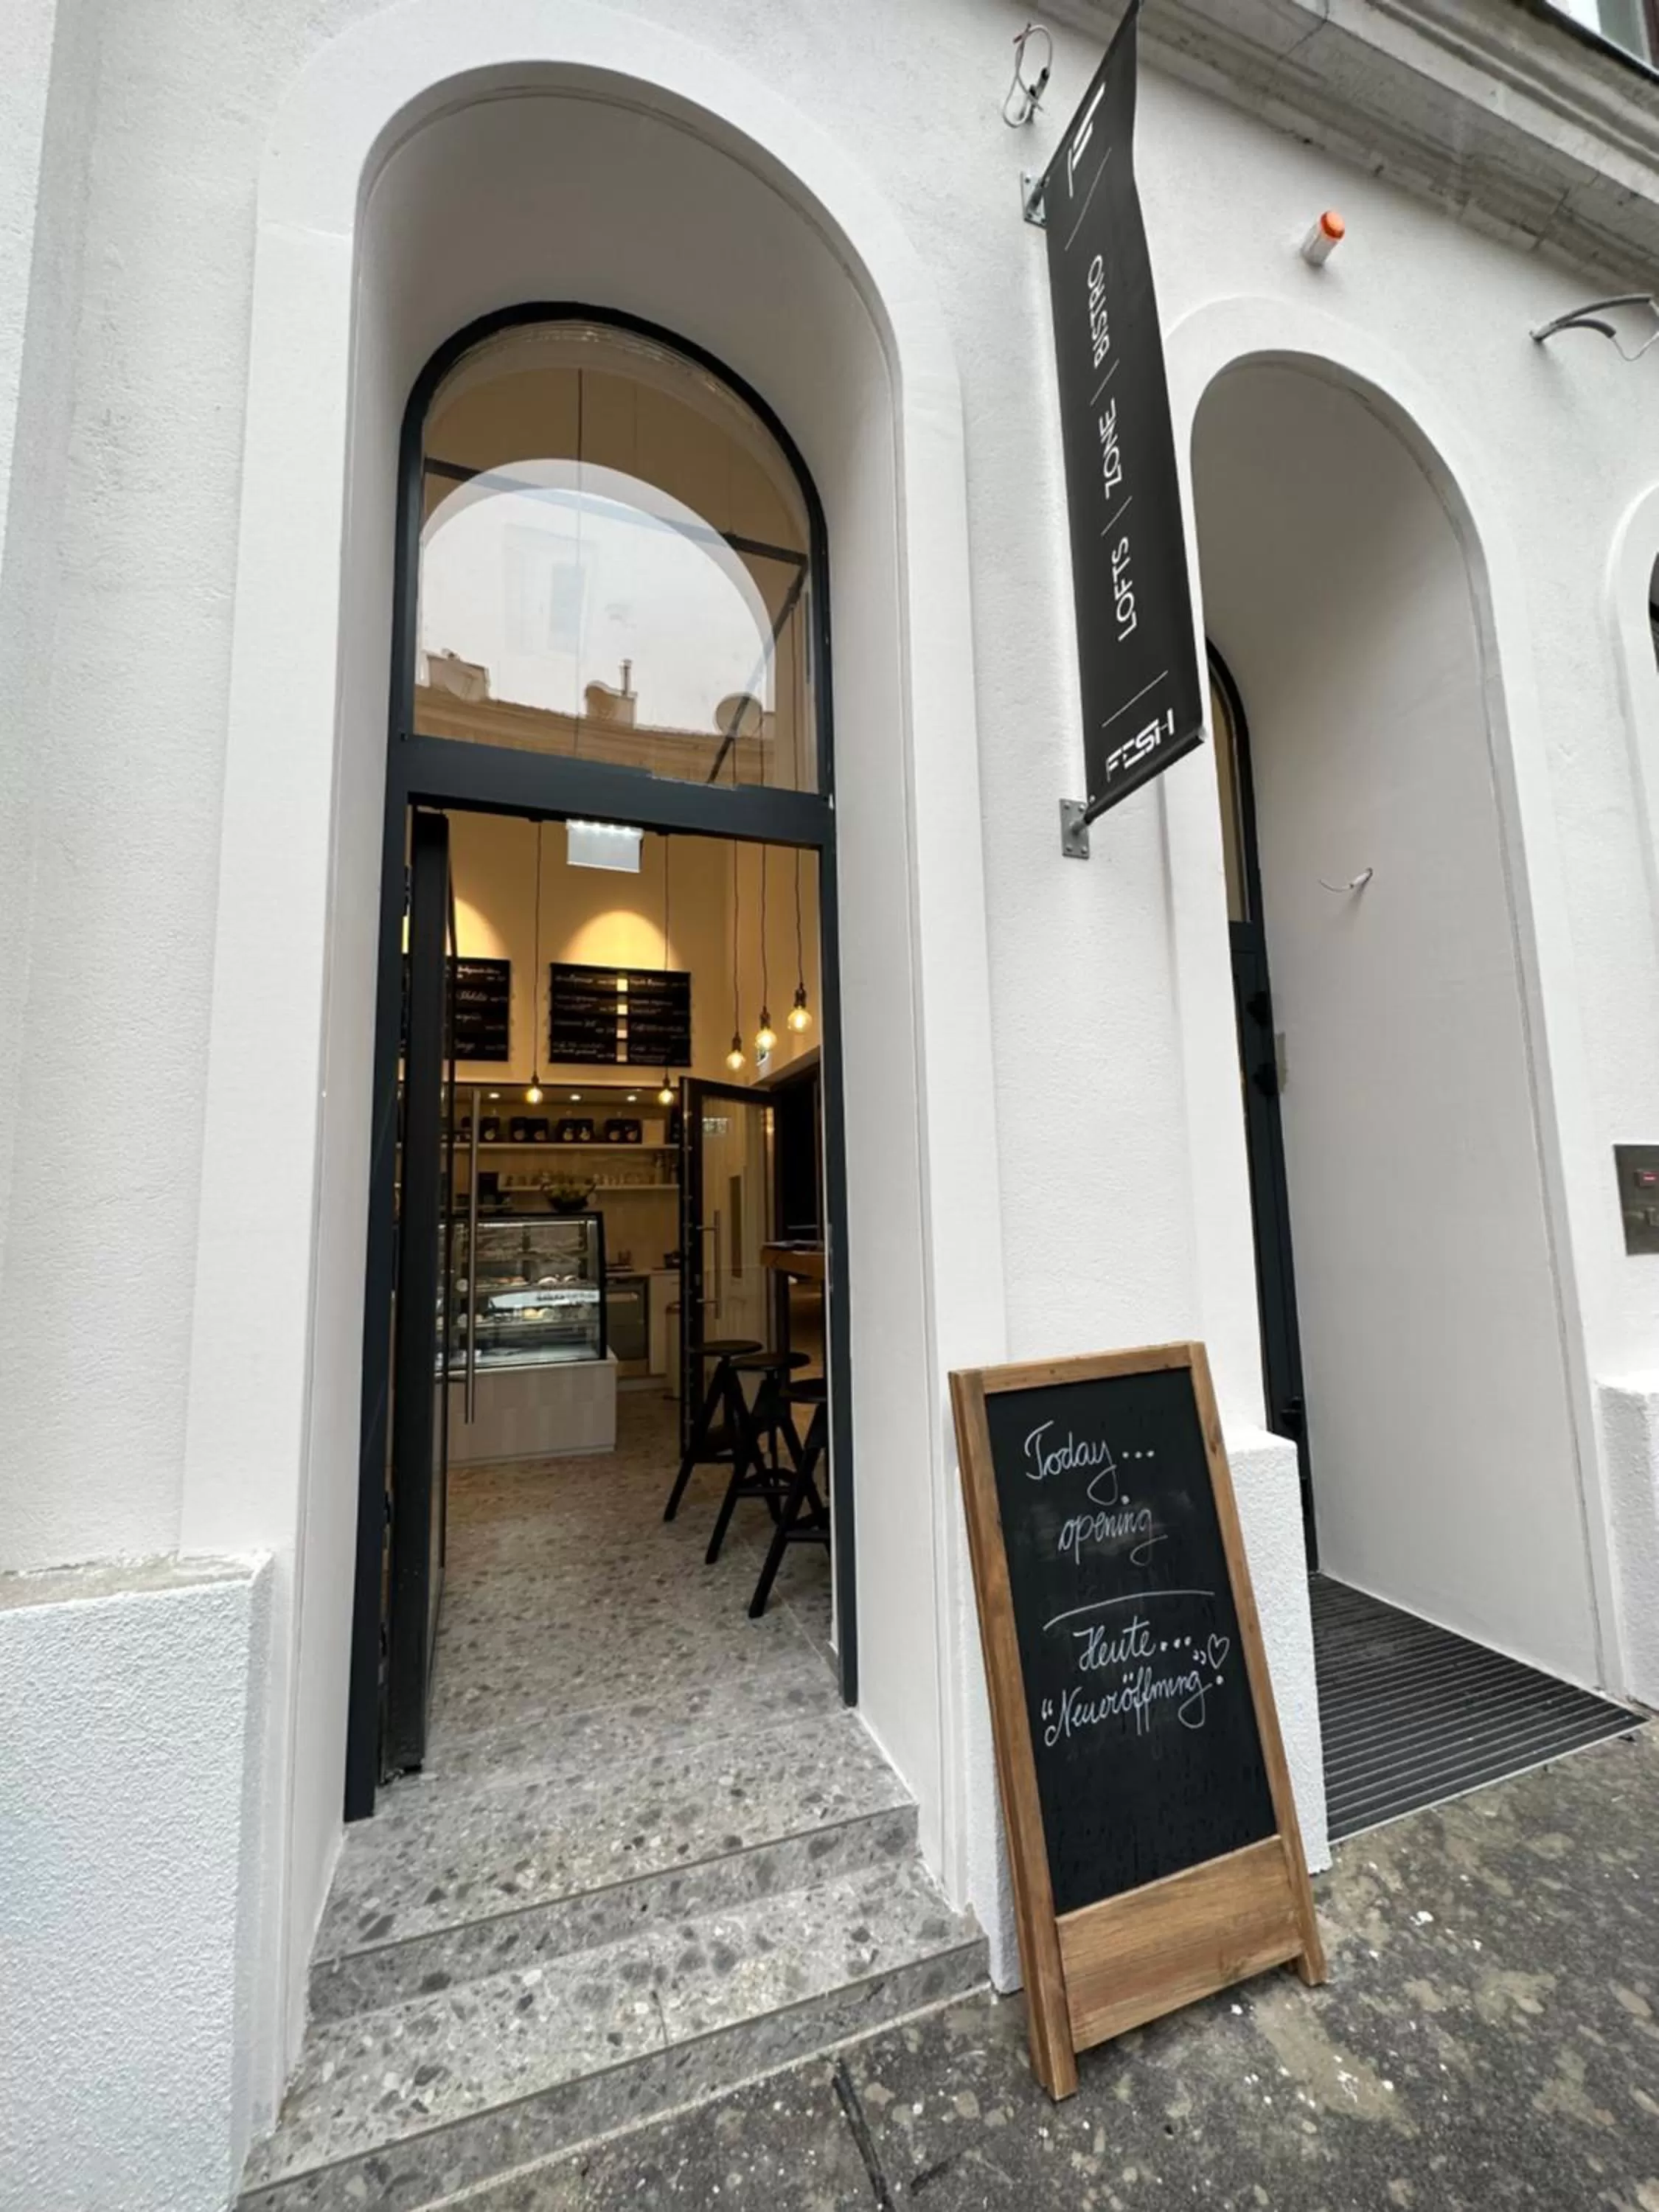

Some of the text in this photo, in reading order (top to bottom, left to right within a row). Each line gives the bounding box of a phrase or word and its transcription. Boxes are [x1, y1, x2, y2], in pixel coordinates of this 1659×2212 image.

[1087, 254, 1137, 641] LOFTS ZONE BISTRO
[1057, 1495, 1169, 1566] opening
